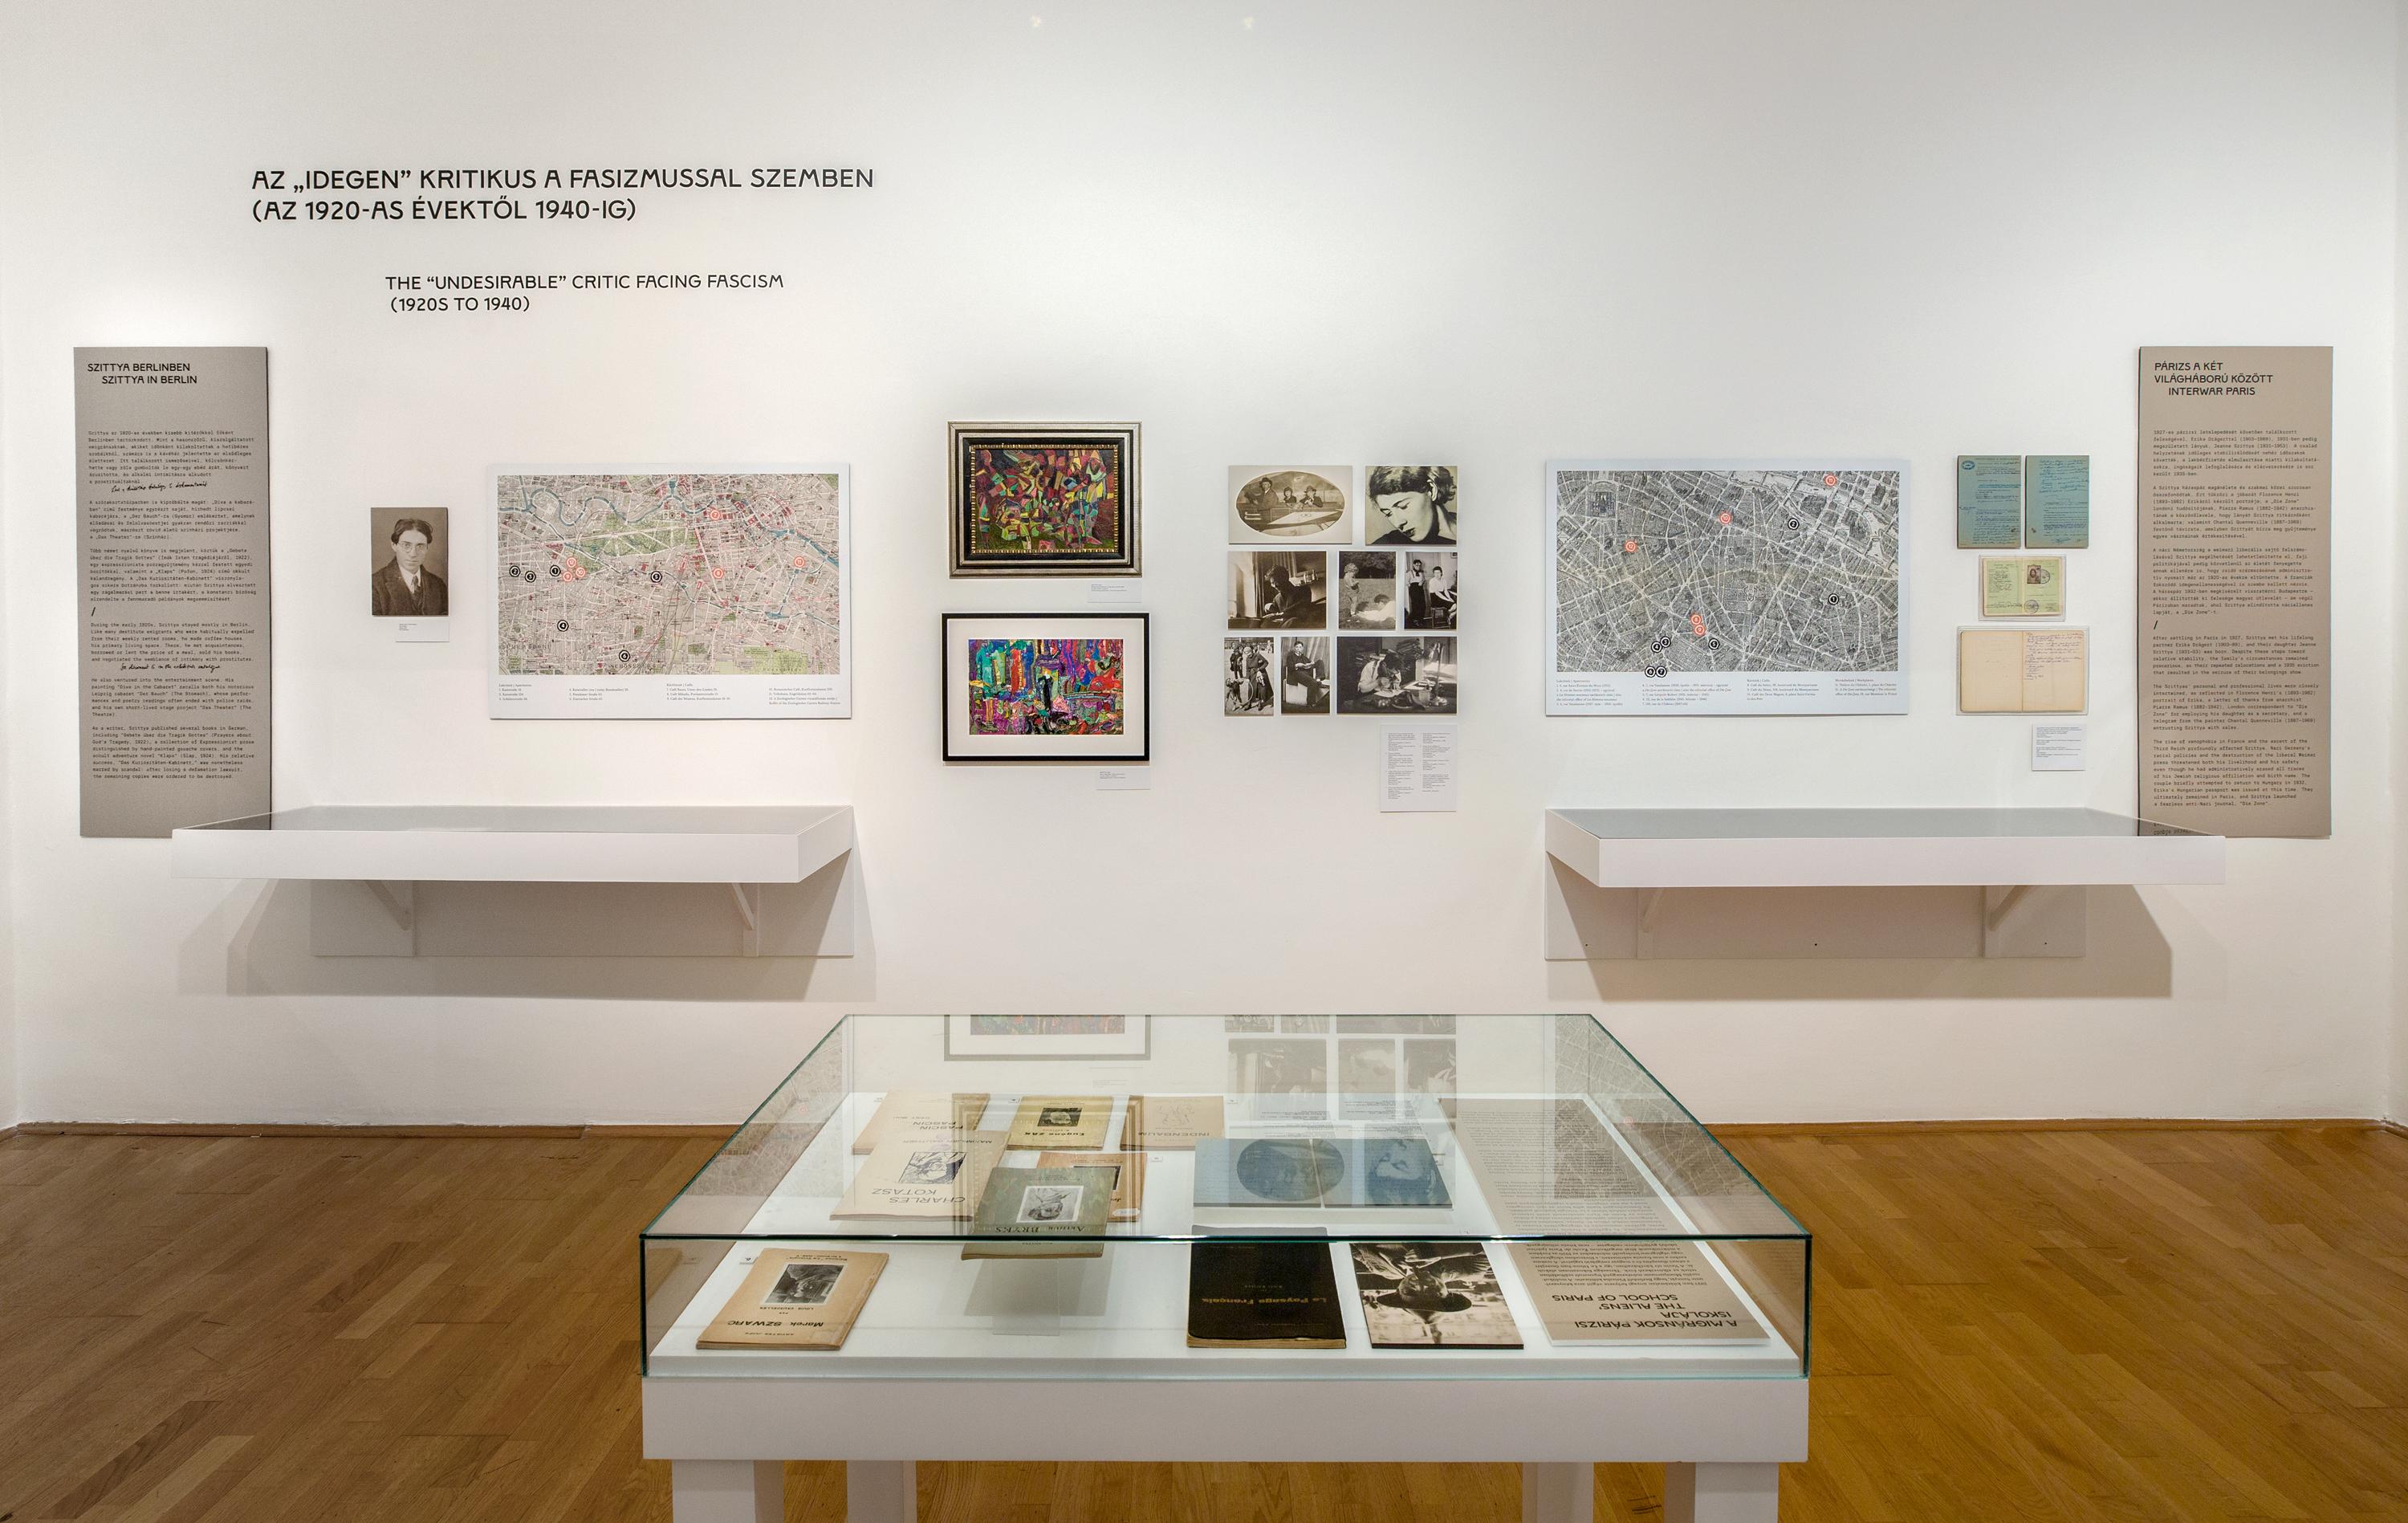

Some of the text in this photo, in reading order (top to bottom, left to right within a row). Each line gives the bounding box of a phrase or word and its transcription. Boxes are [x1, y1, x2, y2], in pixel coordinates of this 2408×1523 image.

[252, 170, 285, 189] AZ
[421, 169, 536, 189] KRITIKUS
[544, 170, 562, 189] A
[570, 169, 741, 189] FASIZMUSSAL
[750, 169, 873, 188] SZEMBEN
[253, 194, 636, 222] (AZ 1920-AS ÉVEKTŐL 1940-IG)
[385, 276, 421, 290] THE
[572, 275, 630, 289] CRITIC
[637, 275, 701, 289] FACING
[707, 274, 783, 288] FASCISM
[391, 295, 530, 312] (1920S TO 1940)
[87, 363, 190, 372] SZITTYA BERLINBEN
[2154, 360, 2223, 371] PÁRIZS A KÉT
[102, 376, 197, 384] SZITTYA IN BERLIN
[2154, 373, 2273, 384] VILÁGHÁBORÚ KÖZÖTT
[2168, 387, 2255, 396] INTERWAR PARIS
[1660, 1310, 1732, 1319] ISKOLÁJA
[1574, 1320, 1631, 1330] PÁRIZSI
[1634, 1319, 1723, 1330] MIGRÁNSOK
